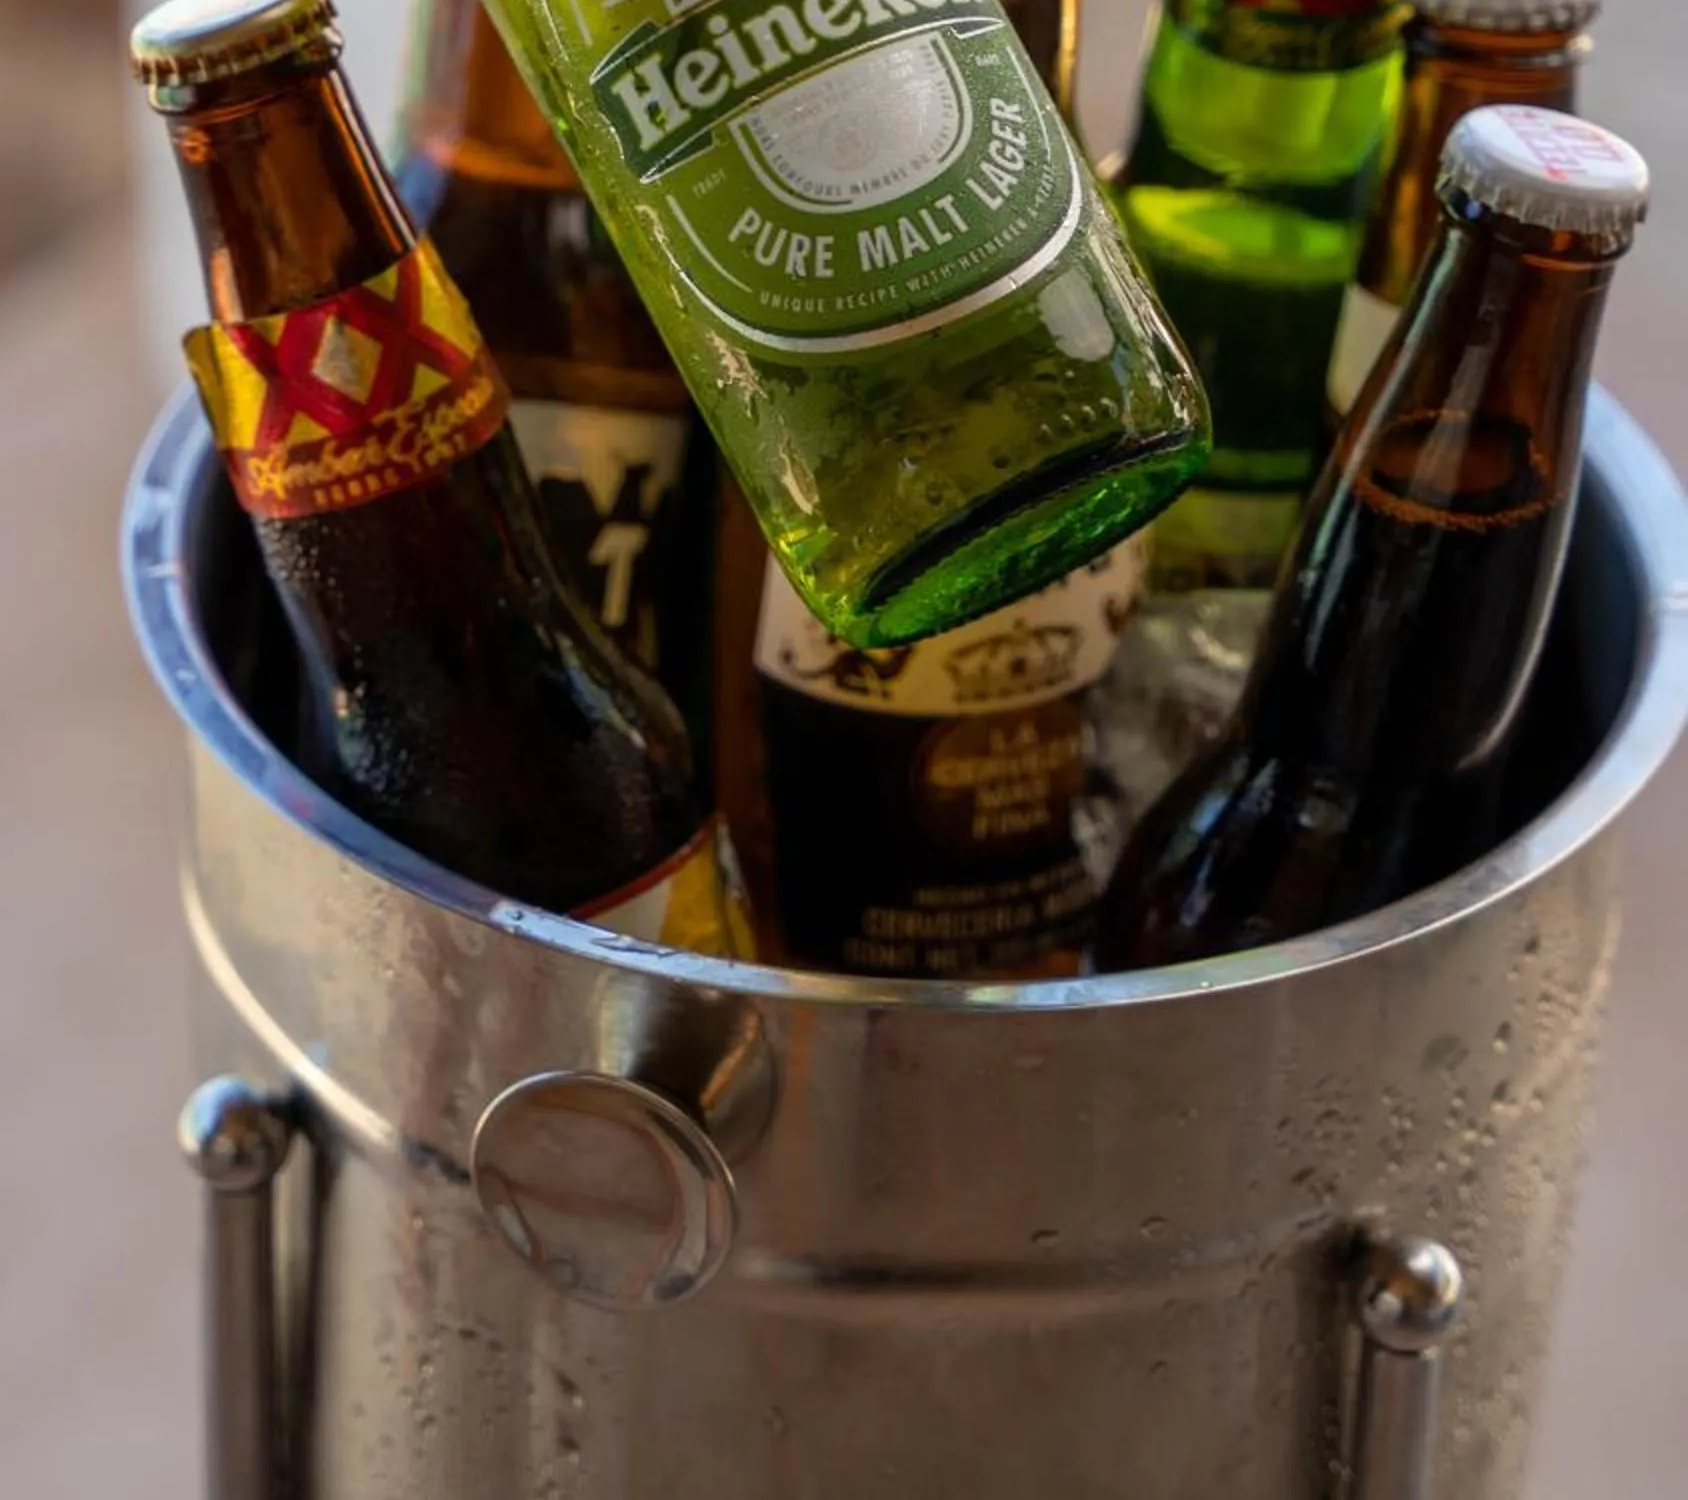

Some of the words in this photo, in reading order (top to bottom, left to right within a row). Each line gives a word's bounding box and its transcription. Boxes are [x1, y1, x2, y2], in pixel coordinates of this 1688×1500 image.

[728, 207, 834, 278] PURE
[857, 193, 969, 273] MALT
[965, 97, 1027, 211] LAGER
[760, 290, 825, 313] UNIQUE
[836, 285, 899, 312] RECIPE
[906, 263, 951, 293] WITH
